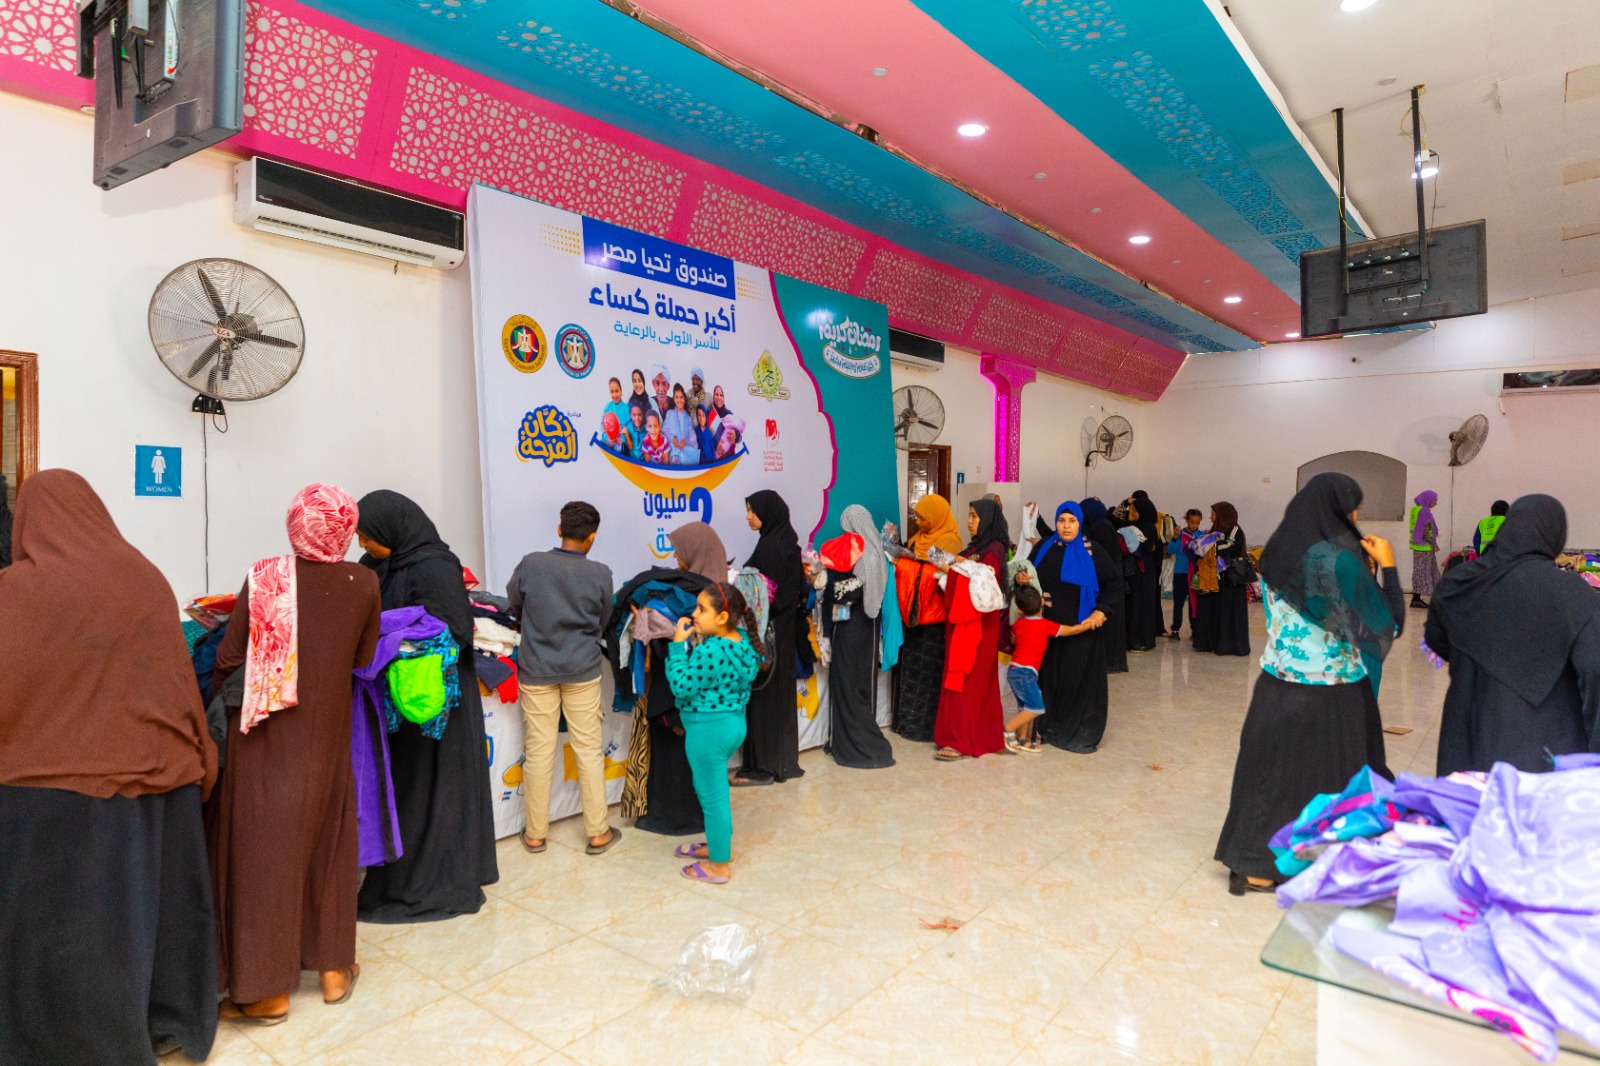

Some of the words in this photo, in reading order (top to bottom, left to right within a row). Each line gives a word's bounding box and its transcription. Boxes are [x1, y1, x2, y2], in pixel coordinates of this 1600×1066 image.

[601, 242, 637, 264] مصر
[641, 247, 672, 275] تحيا
[675, 257, 728, 288] صندوق
[588, 283, 650, 315] كساء
[654, 292, 700, 326] حملة
[613, 320, 656, 342] بالرعاية
[703, 304, 736, 336] أكبر
[658, 330, 692, 347] الأولى
[694, 335, 720, 350] للأسر
[145, 485, 173, 493] WOMEN
[643, 487, 687, 519] مليون
